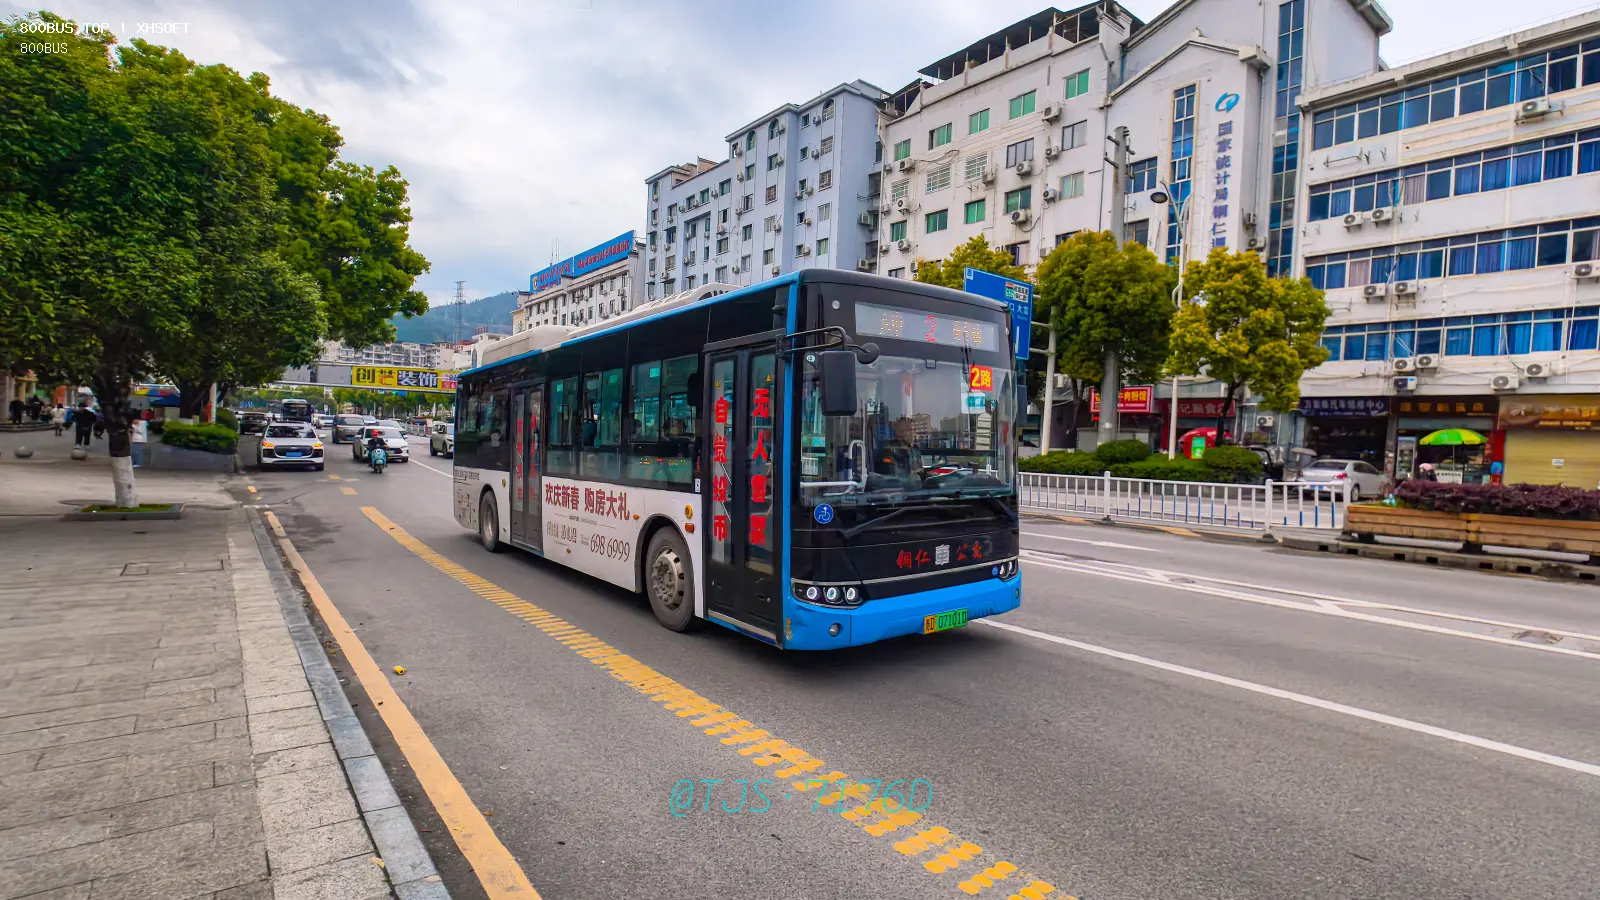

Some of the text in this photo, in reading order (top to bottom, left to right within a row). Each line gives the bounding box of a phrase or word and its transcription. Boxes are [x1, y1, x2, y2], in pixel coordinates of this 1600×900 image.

[925, 315, 937, 342] 2
[971, 367, 991, 387] 2路
[545, 483, 630, 521] 欢庆新春 购房大礼
[590, 533, 606, 555] 698
[607, 538, 631, 562] 6999
